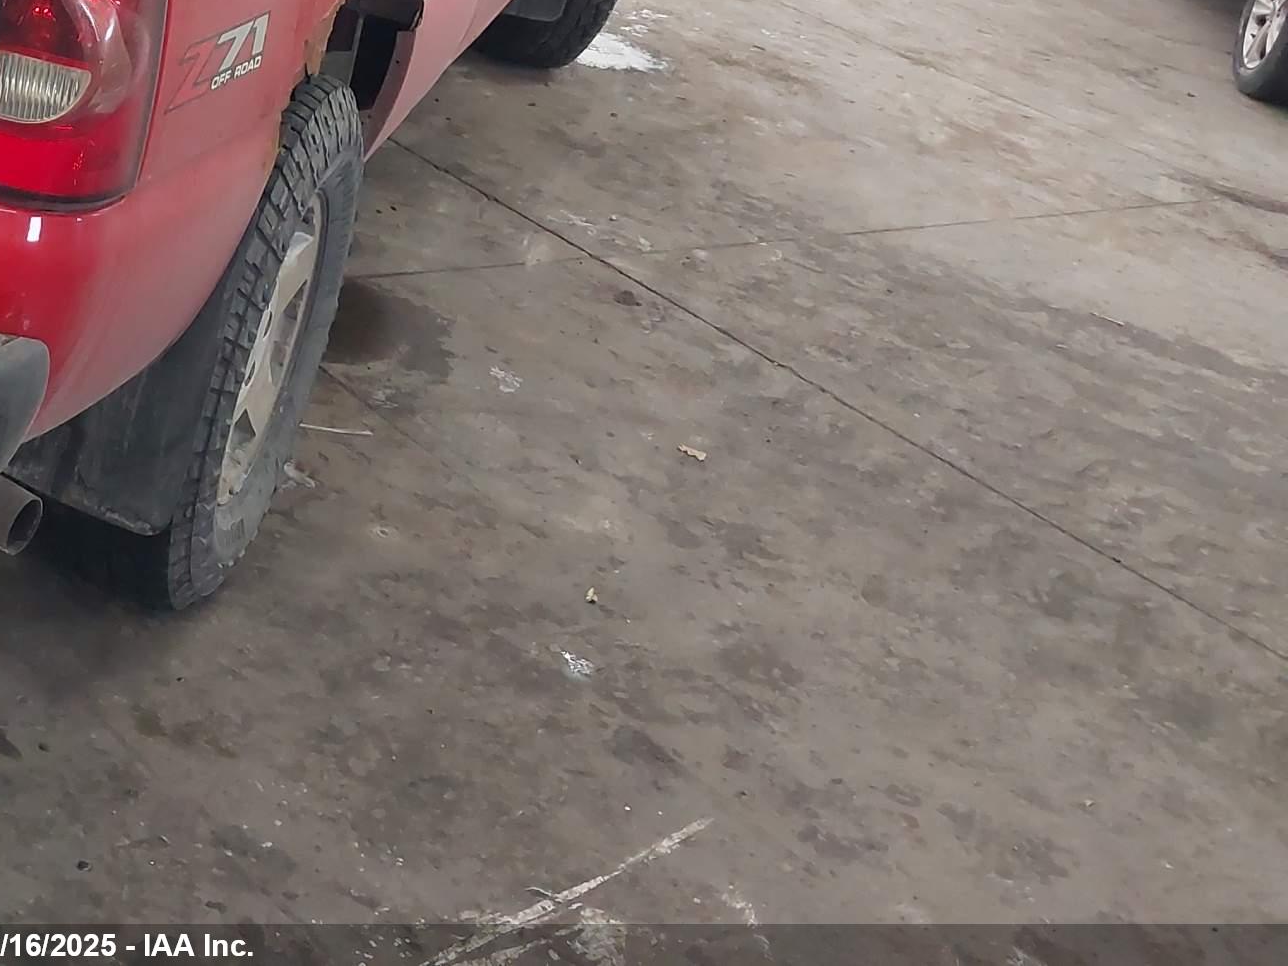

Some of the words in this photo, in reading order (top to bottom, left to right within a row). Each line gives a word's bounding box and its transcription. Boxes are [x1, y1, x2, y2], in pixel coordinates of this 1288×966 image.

[164, 10, 271, 114] Z71
[210, 69, 232, 90] OFF
[233, 56, 262, 79] ROAD
